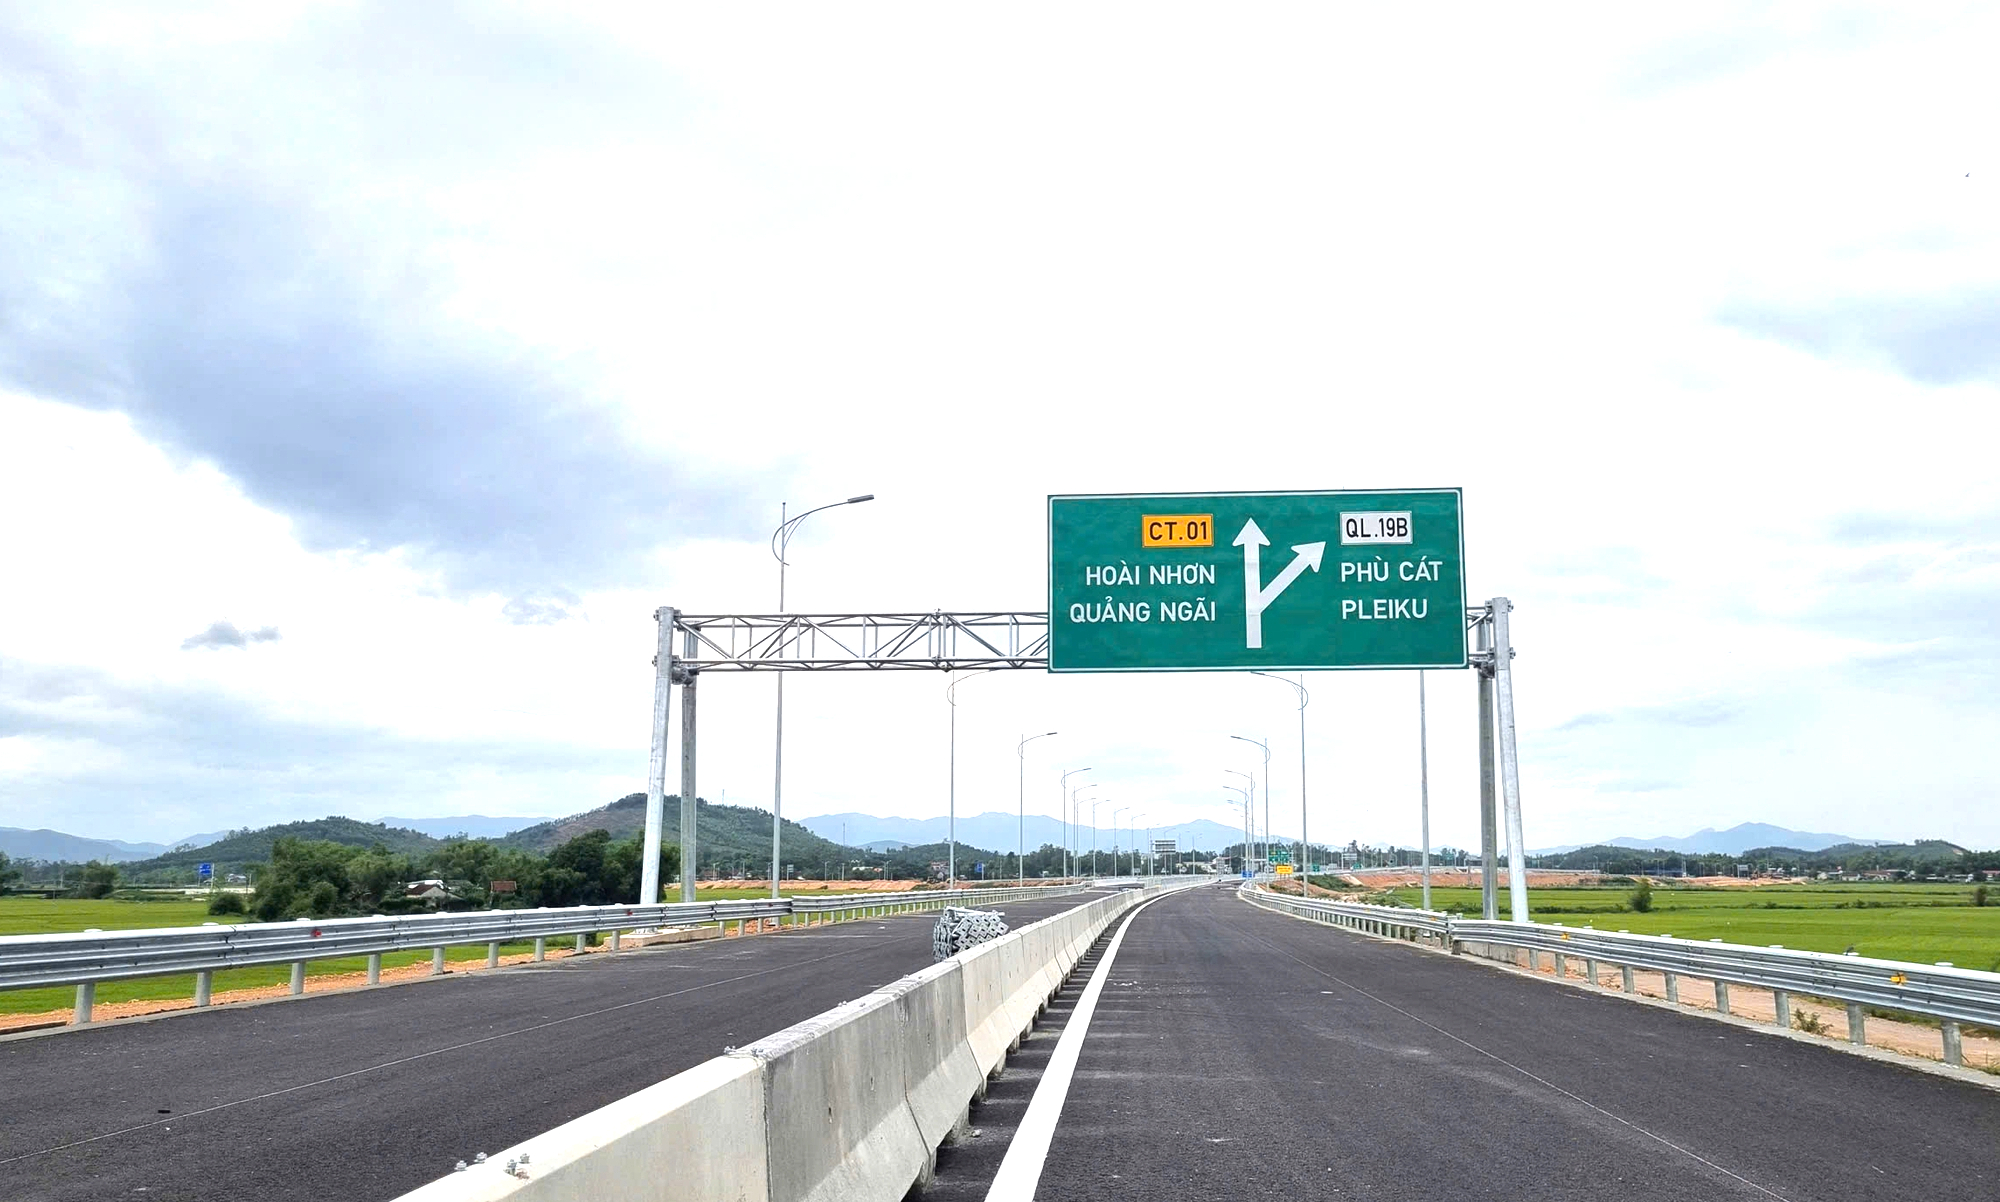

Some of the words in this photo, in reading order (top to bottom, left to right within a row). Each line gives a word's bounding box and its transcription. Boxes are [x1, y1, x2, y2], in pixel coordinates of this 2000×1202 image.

[1149, 521, 1208, 541] CT.01
[1346, 517, 1408, 538] QL.19B
[1086, 560, 1140, 586] HOÀI
[1149, 561, 1215, 585] NHƠN
[1340, 555, 1389, 582] PHÙ
[1399, 555, 1442, 582] CÁT
[1069, 596, 1151, 623] QUẢNG
[1160, 597, 1215, 622] NGÃI
[1341, 599, 1428, 620] PLEIKU
